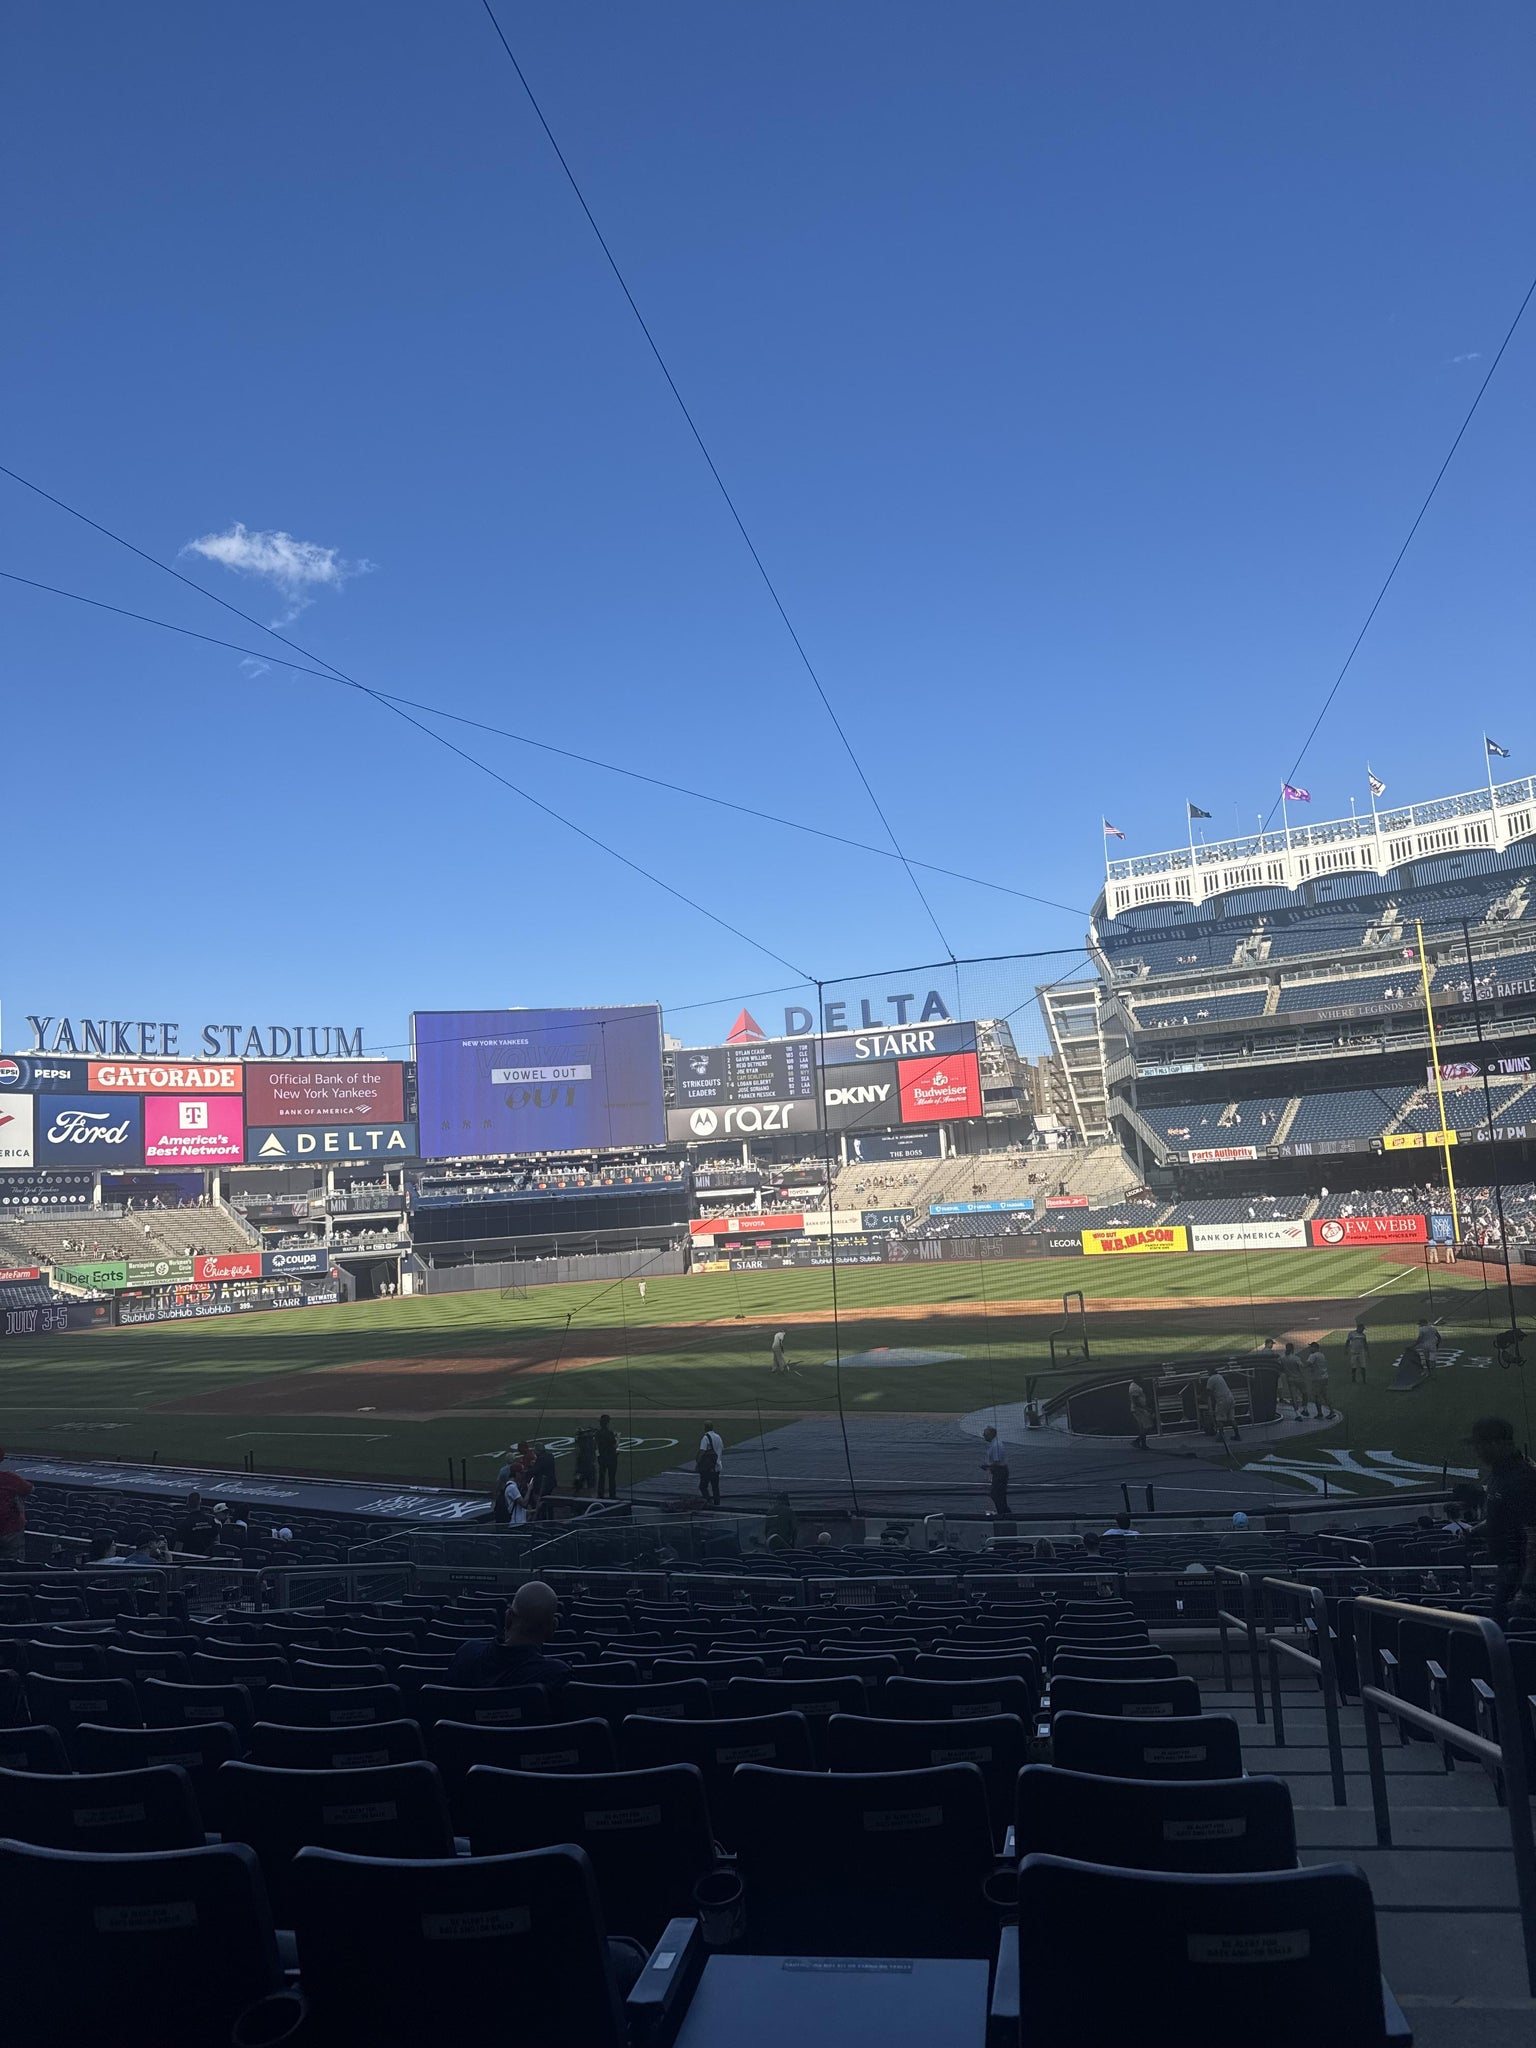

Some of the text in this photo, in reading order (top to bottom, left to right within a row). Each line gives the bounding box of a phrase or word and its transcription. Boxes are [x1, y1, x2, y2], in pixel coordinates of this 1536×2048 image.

[1497, 979, 1536, 998] RAFFLE
[785, 990, 950, 1036] DELTA
[1318, 1001, 1404, 1020] WHERE LEGENDS
[25, 1016, 364, 1058] YANKEE STADIUM
[499, 1038, 529, 1046] YANKEES
[855, 1030, 936, 1059] STARR
[1497, 1057, 1531, 1074] TWINS
[35, 1069, 71, 1079] PEPSI
[98, 1066, 235, 1087] GATORADE
[269, 1073, 381, 1085] Official Bank of the
[504, 1068, 577, 1081] VOWEL OUT
[682, 1079, 721, 1089] STRIKEOUTS
[274, 1087, 378, 1099] New York Yankees
[688, 1089, 717, 1098] LEADERS
[825, 1084, 891, 1106] DKNY
[913, 1086, 967, 1098] Budweiser
[724, 1103, 794, 1133] razr
[47, 1111, 130, 1144] Ford
[1508, 1126, 1526, 1138] PM
[158, 1135, 229, 1145] America's
[297, 1130, 407, 1153] DELTA
[147, 1145, 240, 1156] Best Network
[1192, 1151, 1213, 1159] Parts
[1214, 1148, 1253, 1158] Authority
[1294, 1144, 1312, 1156] MIN
[696, 1176, 710, 1187] MIN
[330, 1200, 346, 1212] MIN
[882, 1214, 911, 1223] CLEAR
[1345, 1219, 1416, 1233] F.W. WEBB
[920, 1240, 942, 1260] MIN
[981, 1238, 1003, 1257] 3-5
[1050, 1240, 1082, 1248] LEGORA
[286, 1254, 316, 1265] coupa
[736, 1261, 762, 1270] STARR
[92, 1271, 124, 1282] Eats
[273, 1298, 300, 1308] STARR
[307, 1294, 337, 1302] CUTWATER
[121, 1304, 232, 1324] StubHub StubHub StubHub
[6, 1307, 68, 1334] JULY 3-5
